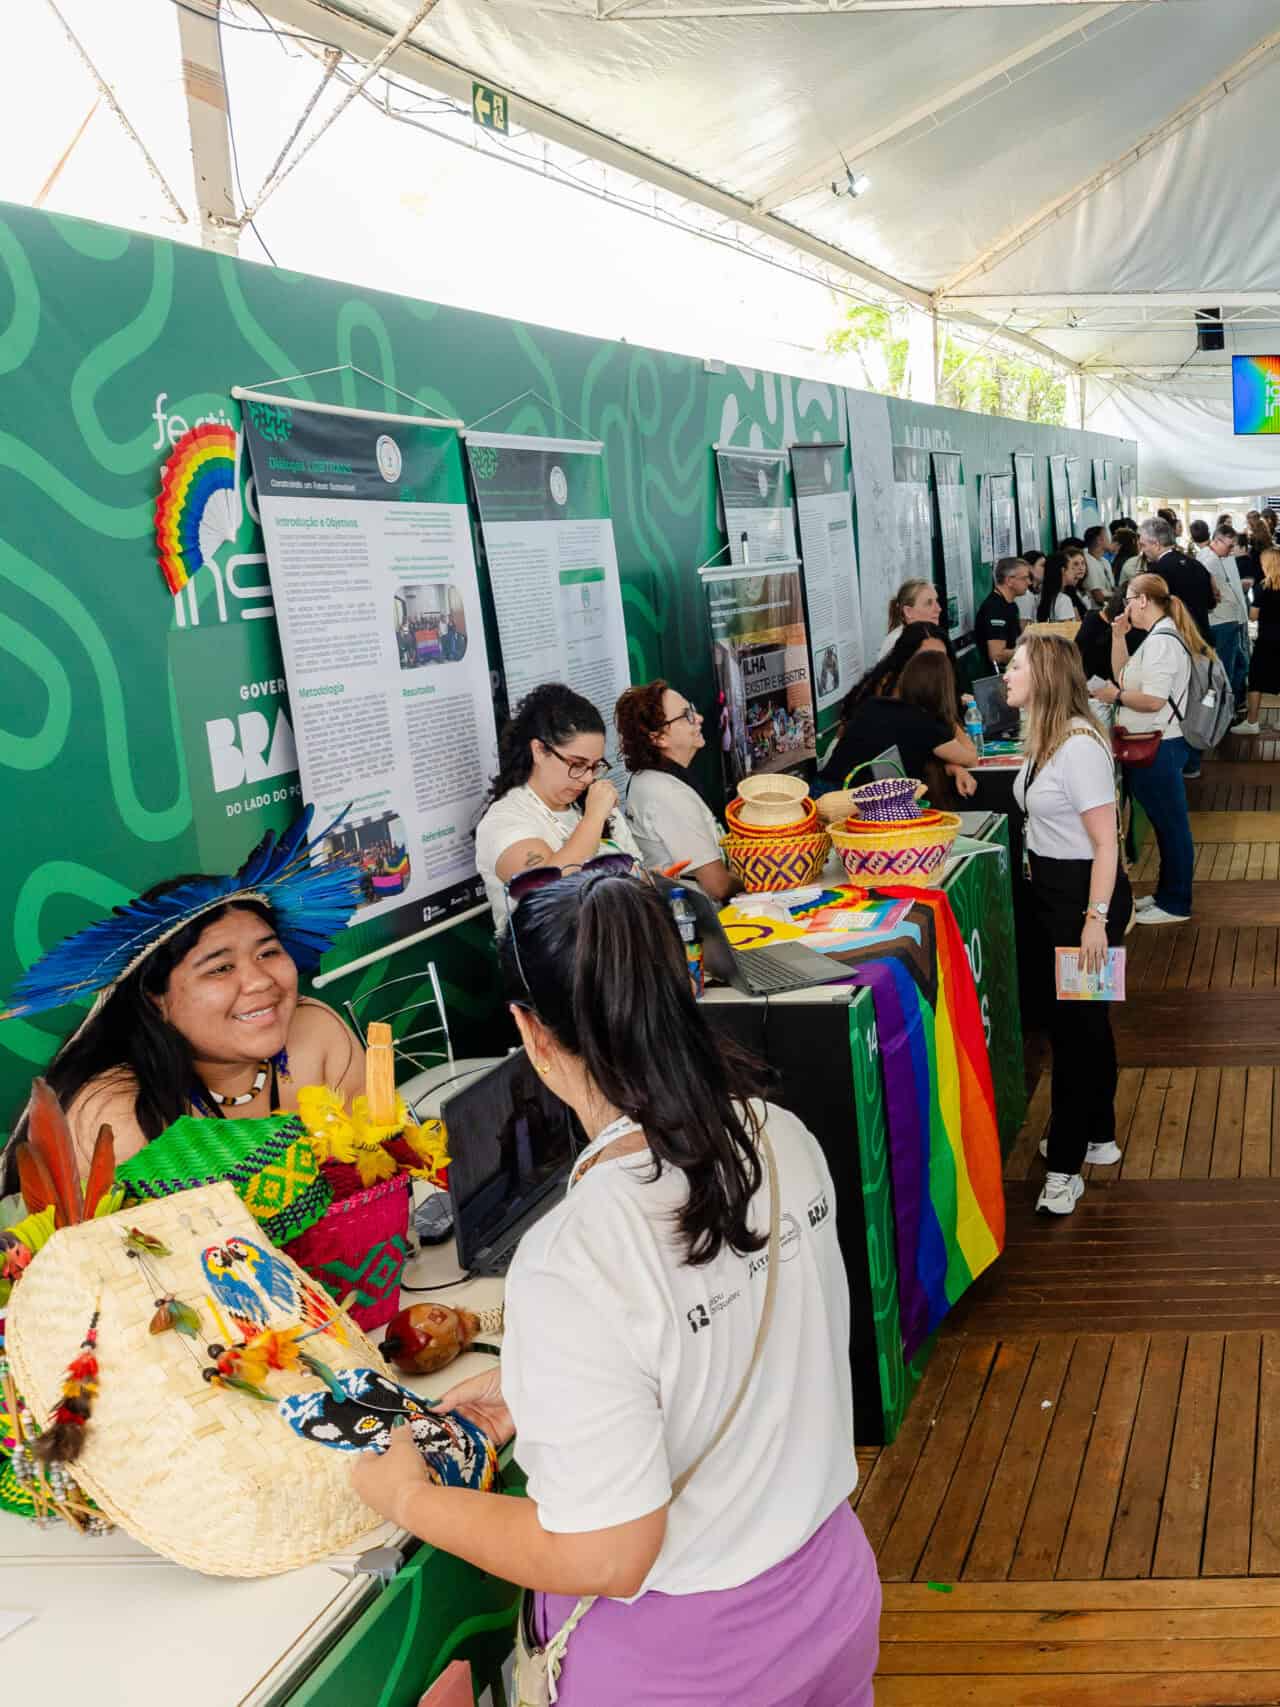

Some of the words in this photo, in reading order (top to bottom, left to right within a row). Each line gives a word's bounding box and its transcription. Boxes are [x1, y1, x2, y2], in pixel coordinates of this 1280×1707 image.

[226, 803, 242, 816] DO
[244, 794, 271, 811] LADO
[273, 789, 287, 802] DO
